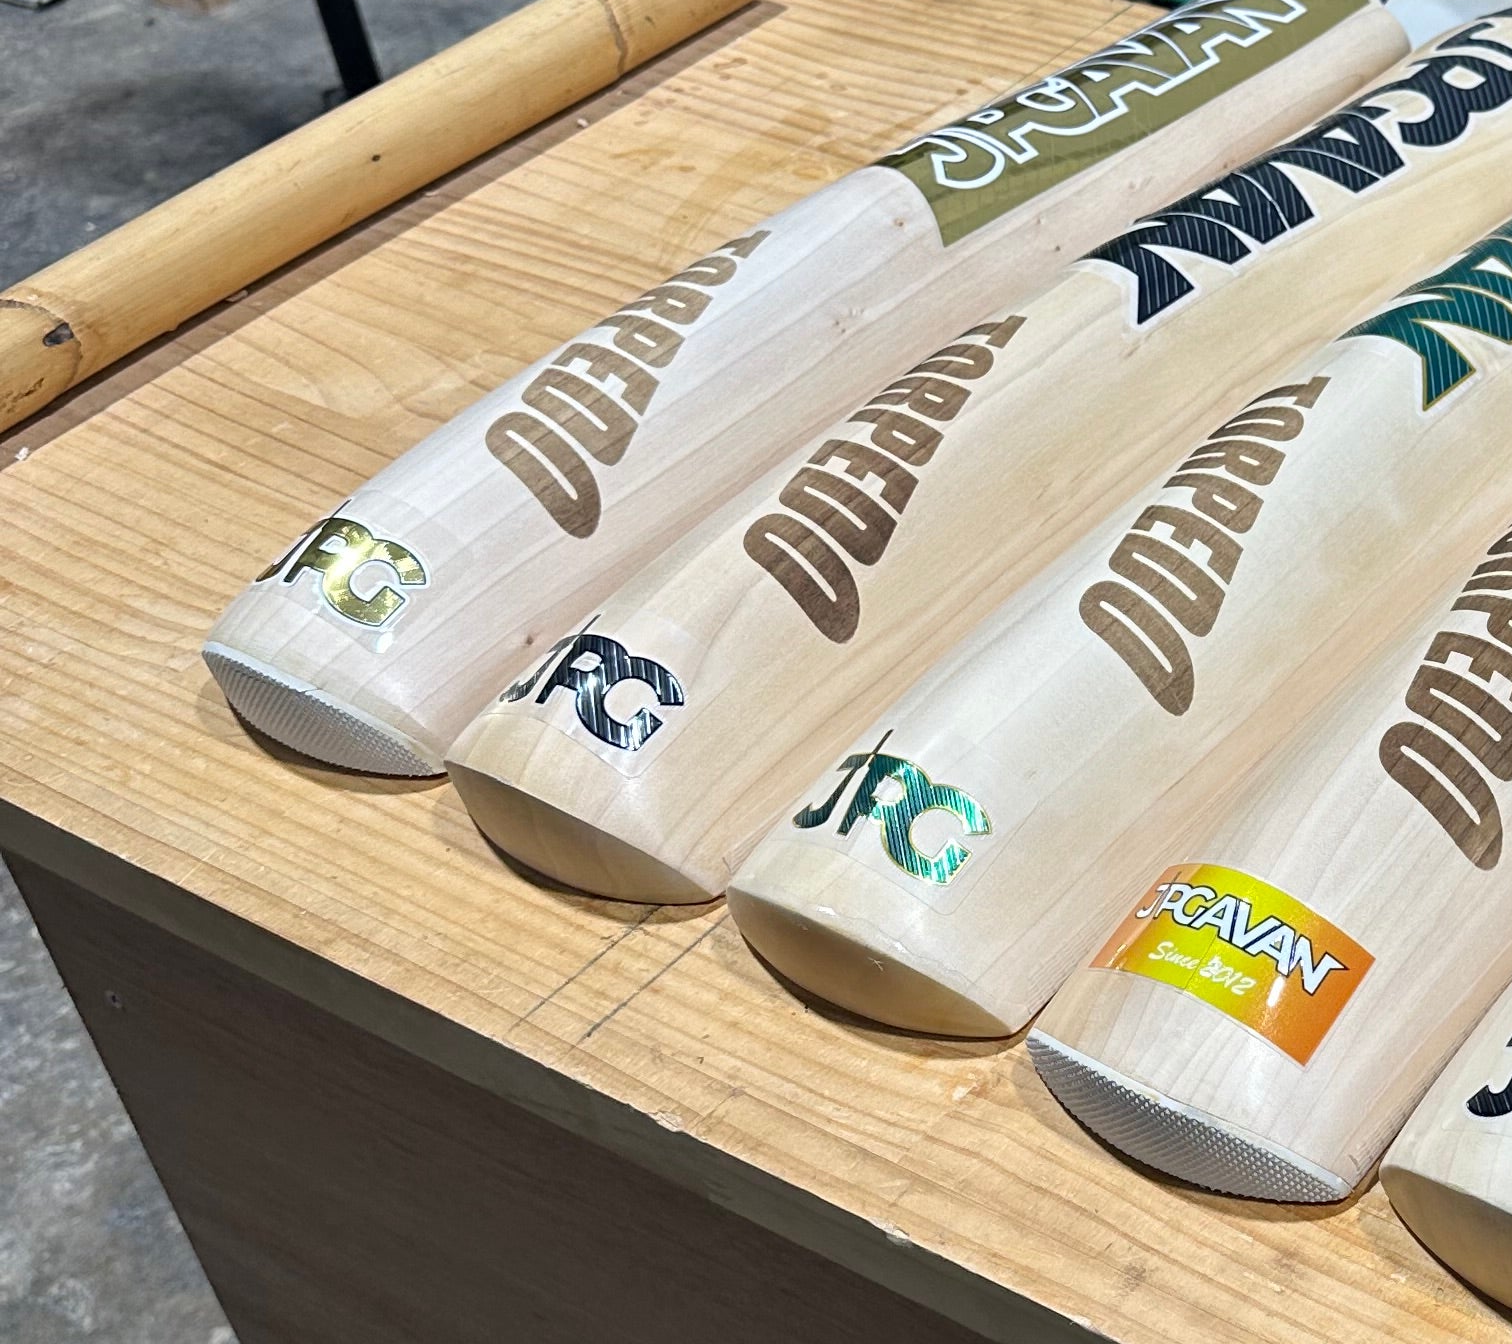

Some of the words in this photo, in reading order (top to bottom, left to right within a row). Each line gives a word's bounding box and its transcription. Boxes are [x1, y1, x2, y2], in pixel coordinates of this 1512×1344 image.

[485, 229, 774, 540] TORPEDO
[743, 315, 1027, 644] TORPEDO
[1079, 376, 1331, 716] TORPEDO
[257, 499, 429, 628] JPG
[498, 614, 686, 752] JPG
[793, 729, 992, 886] JPG
[1135, 871, 1350, 996] JPGAVAN
[1148, 941, 1200, 969] Since
[1199, 955, 1257, 995] 2012
